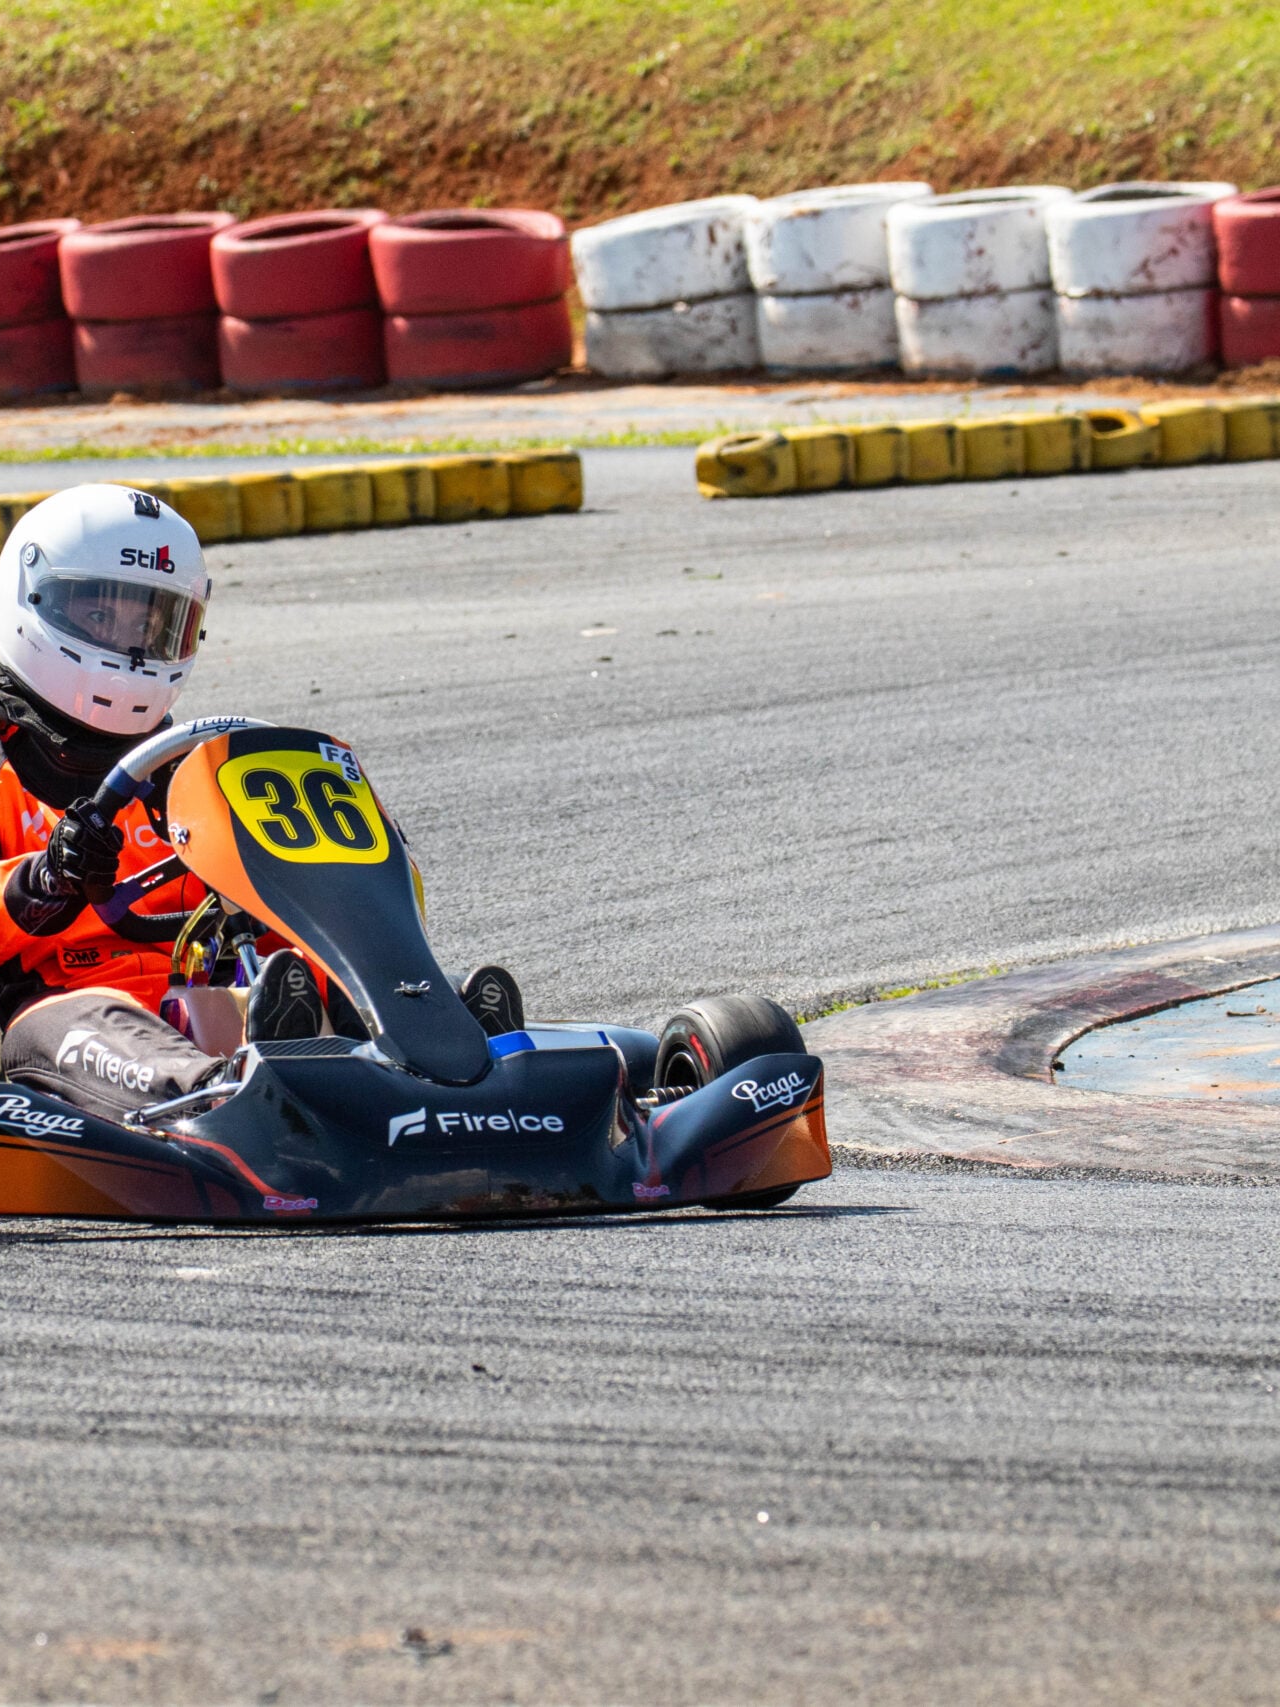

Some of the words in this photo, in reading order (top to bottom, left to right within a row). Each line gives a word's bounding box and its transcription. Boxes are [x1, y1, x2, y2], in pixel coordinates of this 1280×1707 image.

[120, 544, 175, 574] Stilo
[325, 746, 356, 768] F4
[346, 766, 362, 783] S
[241, 768, 378, 851] 36
[63, 950, 100, 964] OMP
[731, 1072, 811, 1113] Praga
